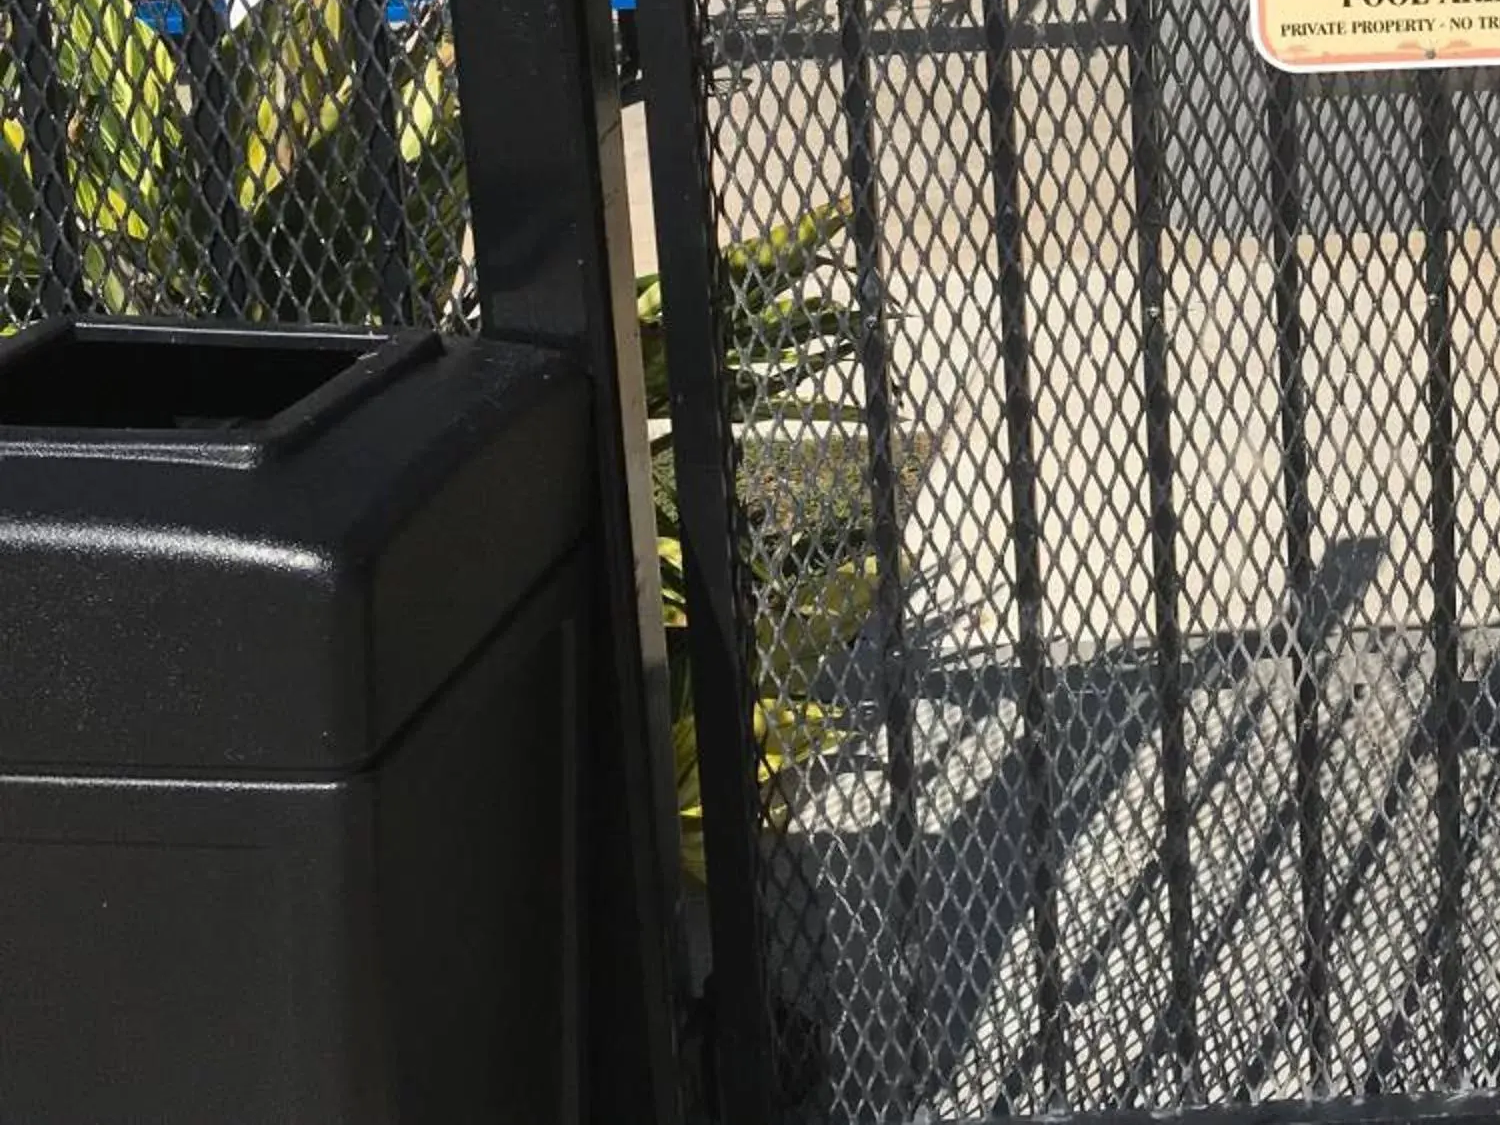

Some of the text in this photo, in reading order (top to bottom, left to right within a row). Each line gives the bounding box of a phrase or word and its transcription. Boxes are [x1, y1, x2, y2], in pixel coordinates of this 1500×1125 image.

[1280, 21, 1347, 38] PRIVATE
[1351, 18, 1435, 35] PROPERTY
[1449, 17, 1473, 30] NO
